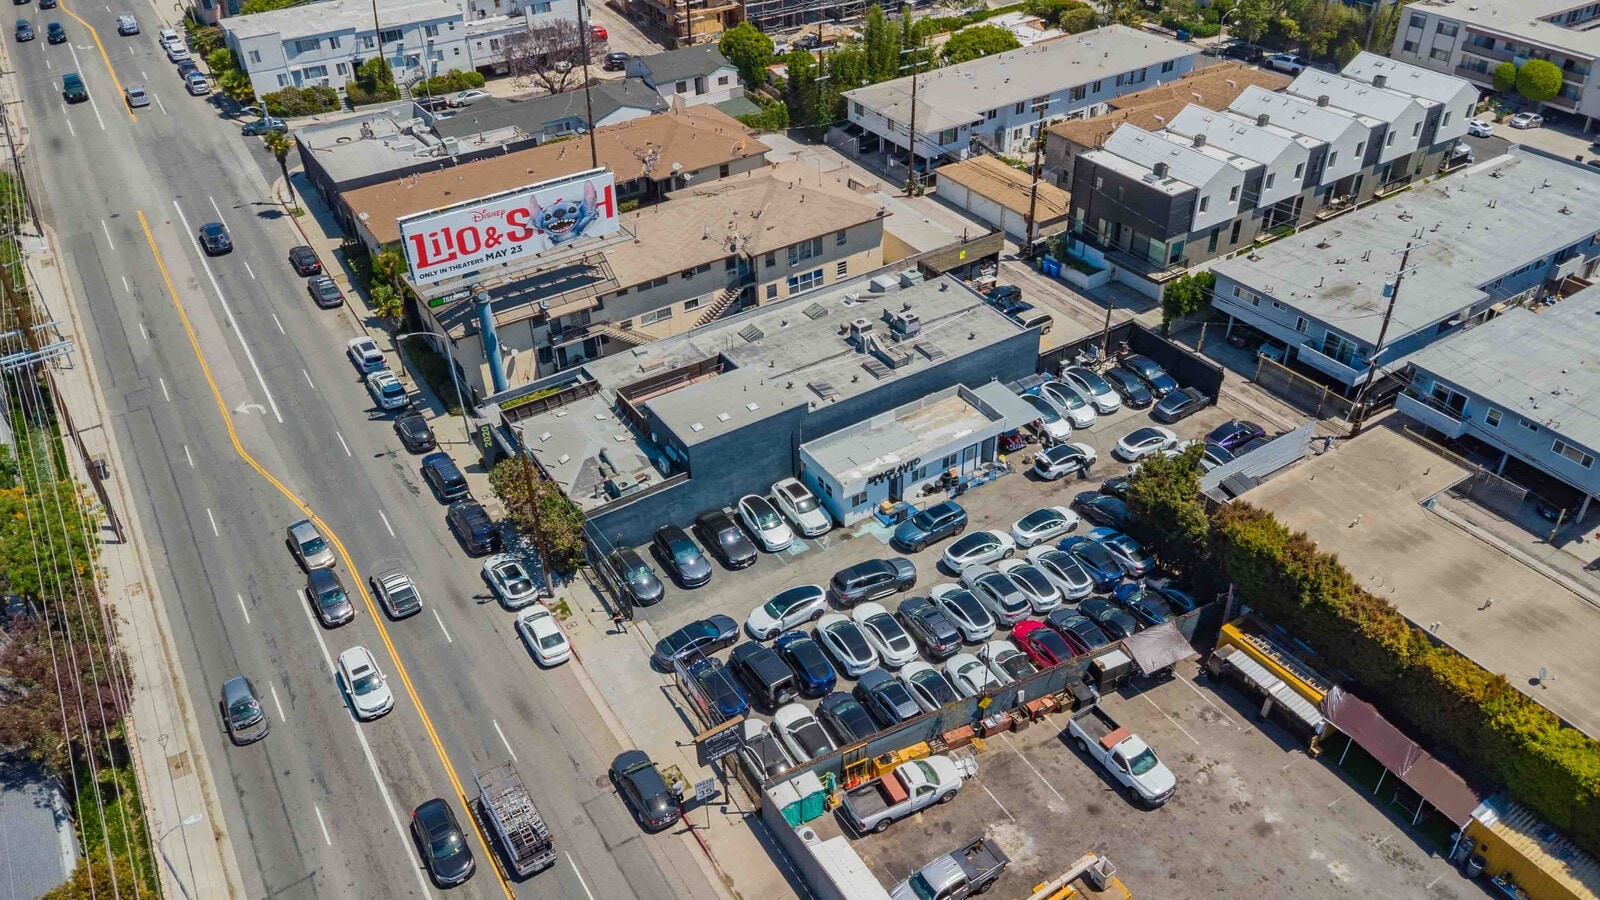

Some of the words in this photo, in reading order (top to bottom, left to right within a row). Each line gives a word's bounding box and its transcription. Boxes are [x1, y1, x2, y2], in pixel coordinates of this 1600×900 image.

[484, 226, 504, 248] &
[419, 270, 438, 280] ONLY
[449, 258, 485, 272] THEATERS
[485, 248, 508, 261] MAY
[510, 244, 523, 255] 23
[481, 426, 493, 448] 2020
[698, 788, 713, 798] 35
